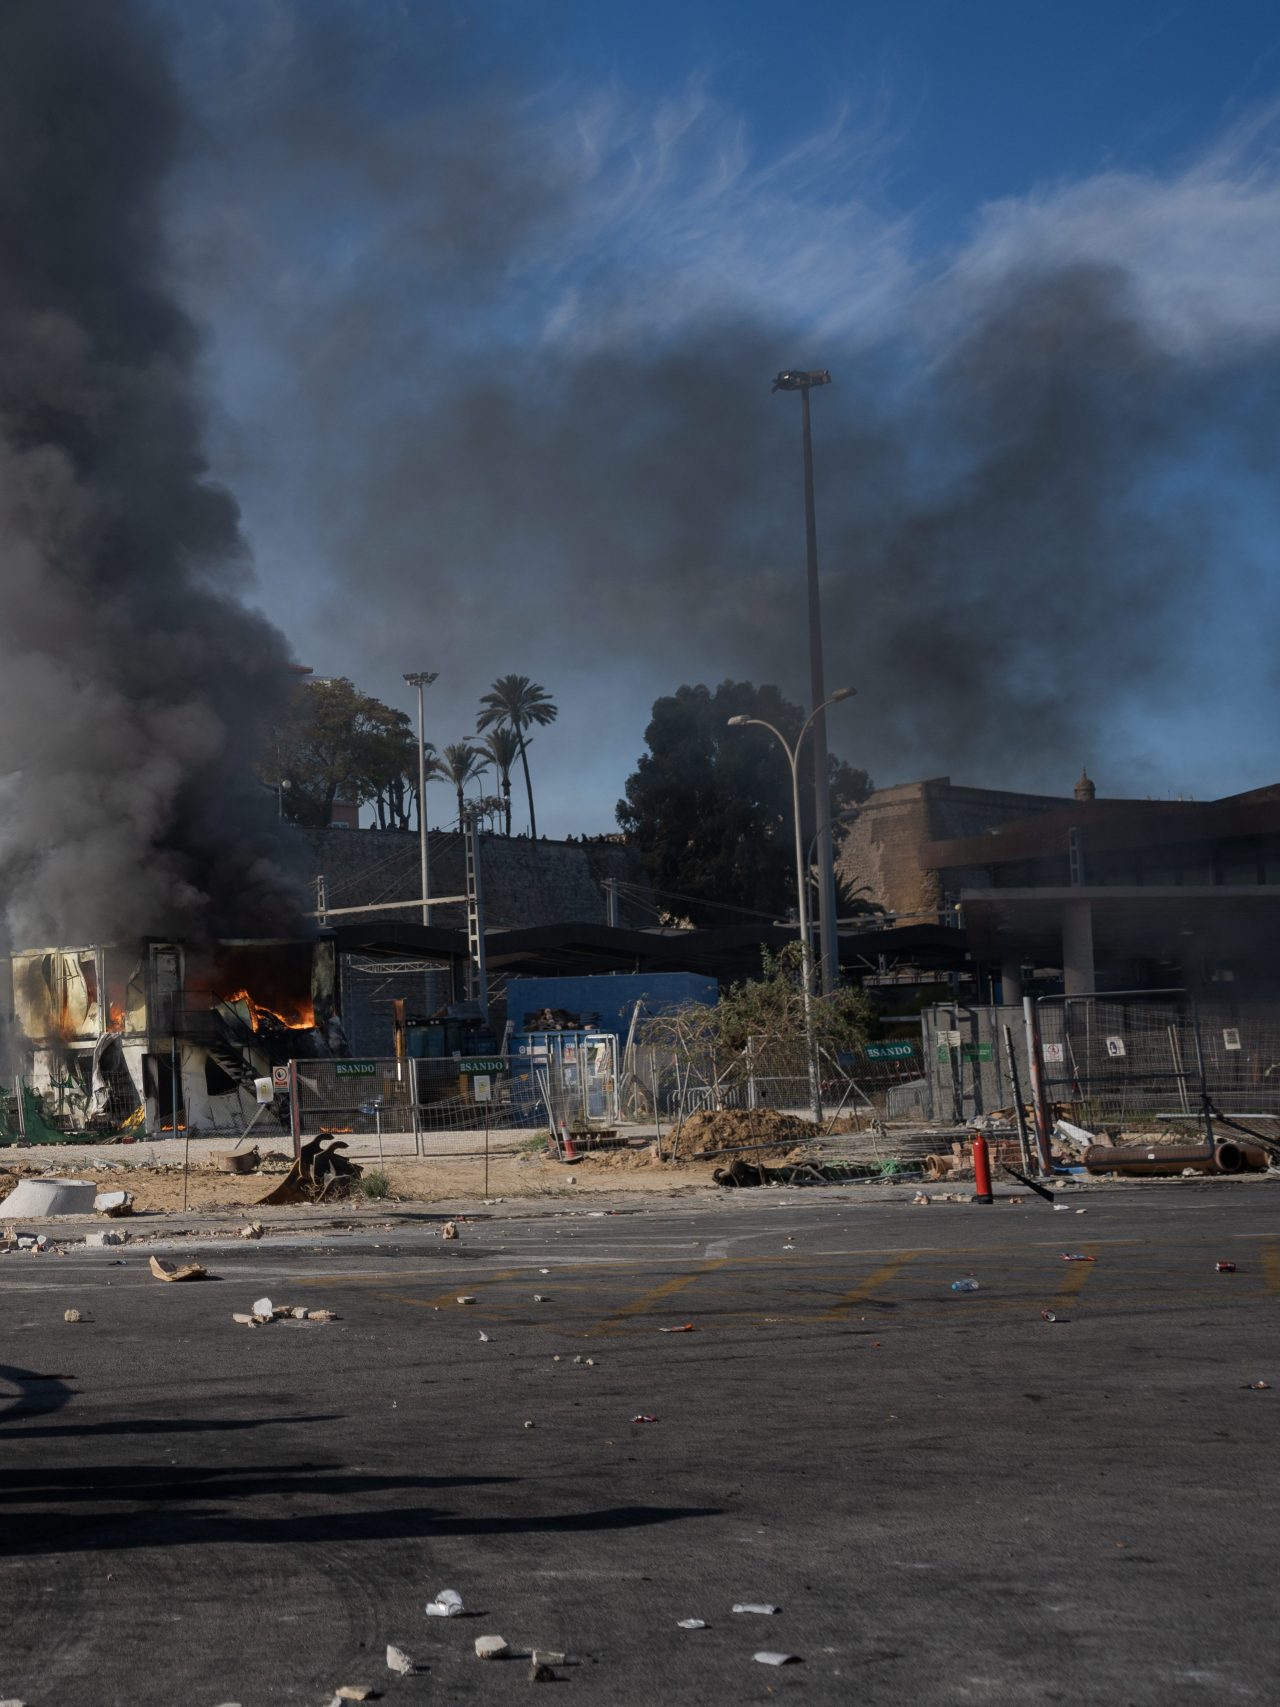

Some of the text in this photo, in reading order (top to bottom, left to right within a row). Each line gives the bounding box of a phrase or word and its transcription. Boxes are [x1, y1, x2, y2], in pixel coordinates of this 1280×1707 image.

[872, 1045, 912, 1057] SANDO
[341, 1064, 375, 1074] SANDO
[465, 1061, 503, 1071] SANDO
